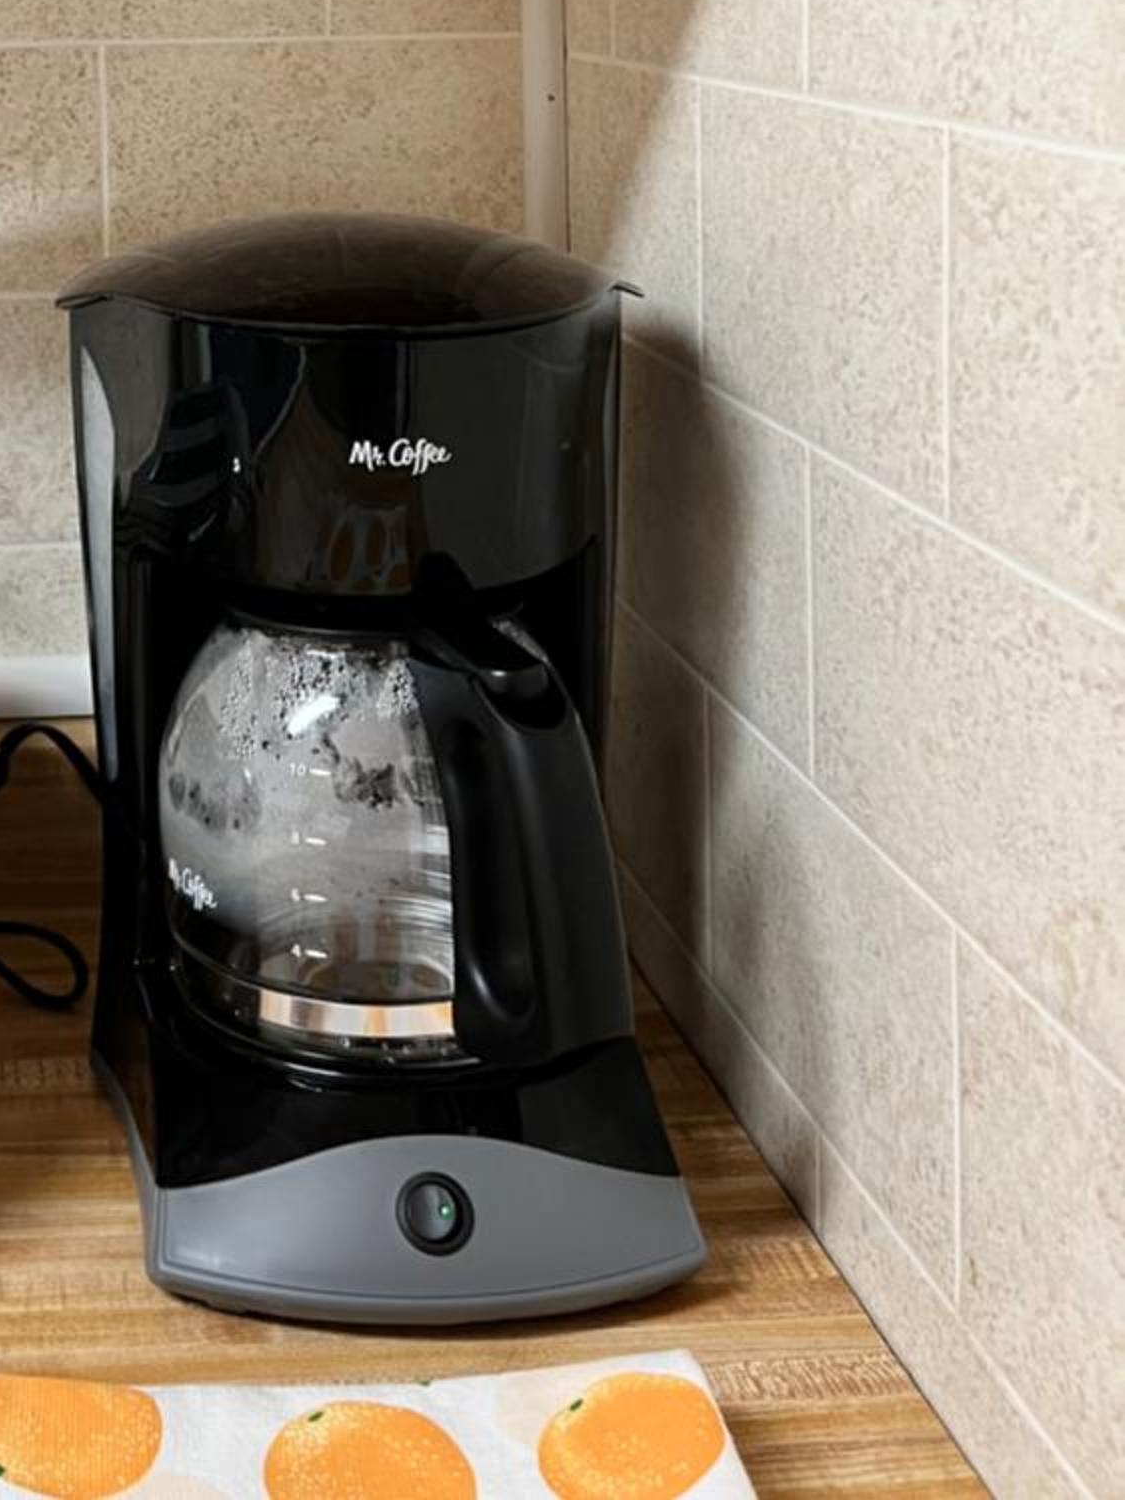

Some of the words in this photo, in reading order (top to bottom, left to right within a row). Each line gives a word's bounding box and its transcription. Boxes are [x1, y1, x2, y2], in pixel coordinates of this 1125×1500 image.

[349, 440, 387, 472] Mr.
[389, 438, 452, 476] Coffee
[290, 763, 306, 777] 10
